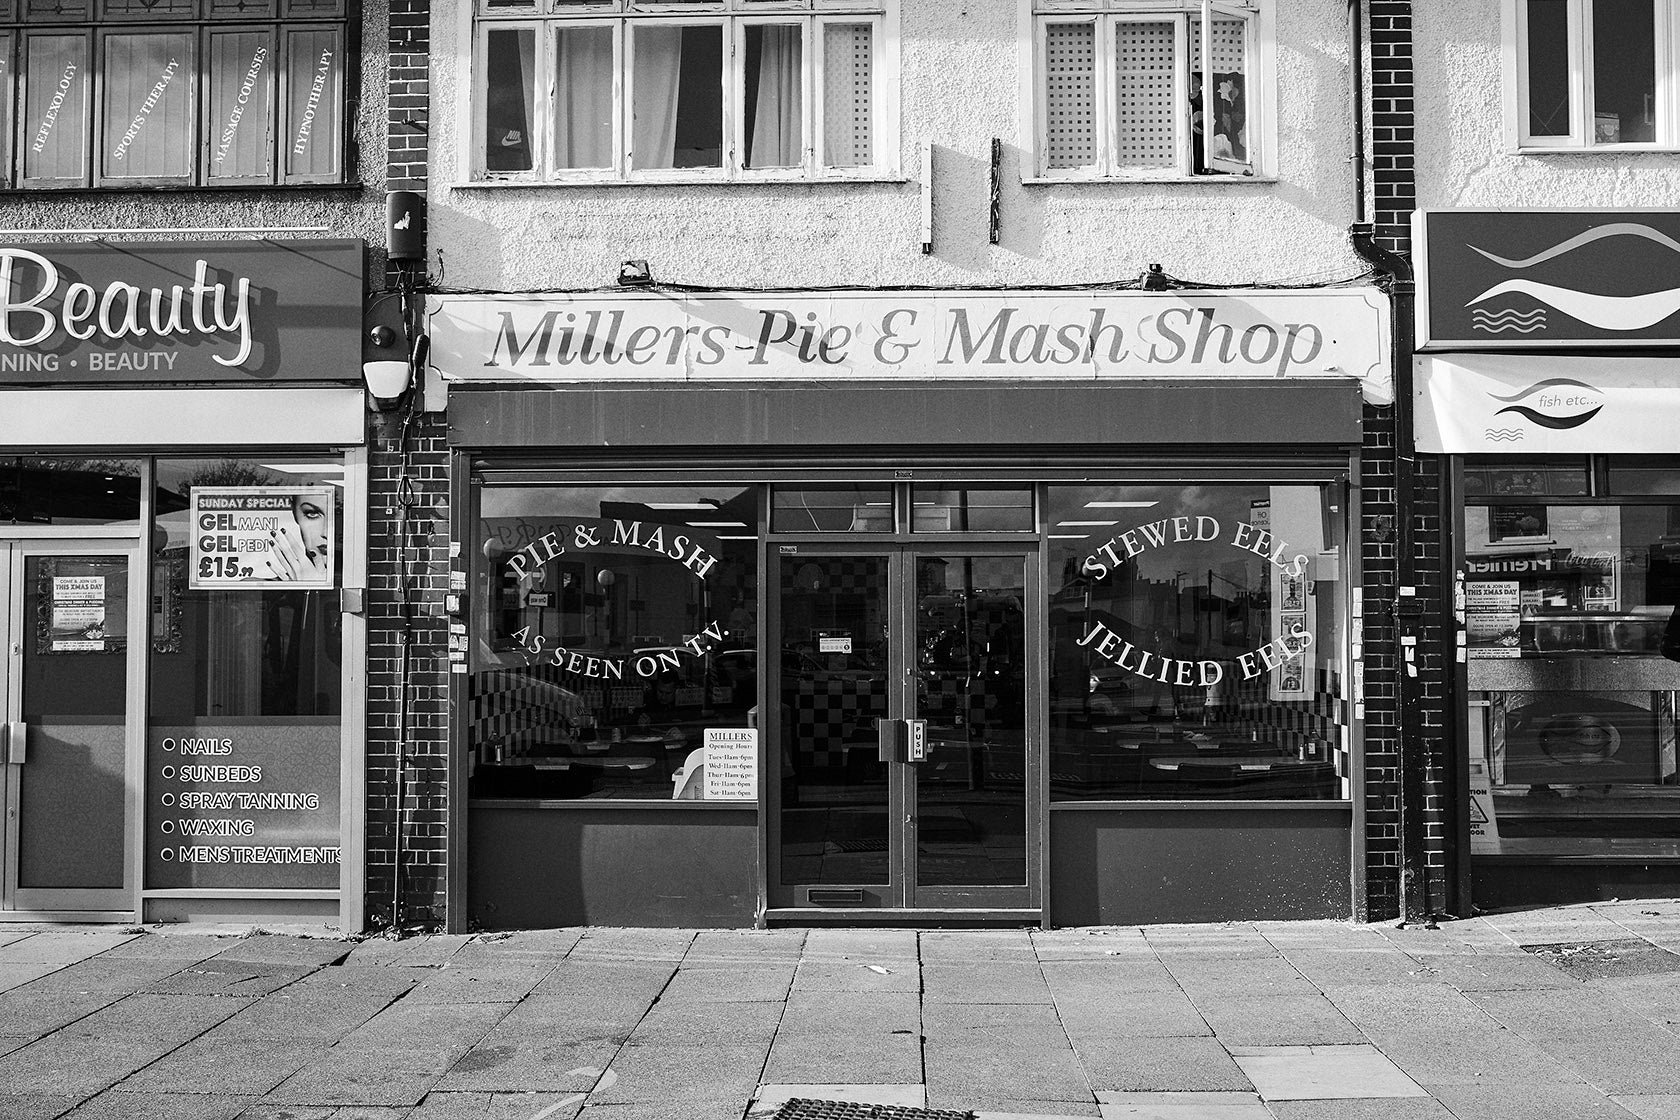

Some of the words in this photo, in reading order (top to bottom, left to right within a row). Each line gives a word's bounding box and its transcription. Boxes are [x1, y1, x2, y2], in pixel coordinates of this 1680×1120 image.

[31, 60, 78, 154] REFLEXOLOGY
[111, 113, 146, 161] SPORTS
[140, 57, 181, 118] THERAPY
[214, 104, 243, 165] MASSAGE
[237, 45, 268, 108] COURSES
[292, 47, 333, 155] HYPNOTHERAPY
[0, 248, 251, 367] Beauty
[873, 308, 921, 365] &
[937, 307, 1129, 365] Mash
[1147, 307, 1323, 377] Shop
[89, 351, 179, 372] BEAUTY
[1538, 395, 1562, 408] fish
[1566, 396, 1598, 407] etc...
[198, 498, 244, 509] SUNDAY
[246, 498, 292, 509] SPECIAL
[199, 513, 237, 531] GEL
[238, 517, 278, 531] MANI
[199, 535, 237, 553] GEL
[238, 539, 269, 553] PEDI
[506, 531, 566, 582] PIE
[574, 523, 601, 550] &
[611, 519, 719, 580] MASH
[1082, 516, 1220, 581] STEWED
[1230, 521, 1310, 578] EELS
[198, 556, 254, 578] £15.99
[510, 624, 546, 655] AS
[550, 647, 624, 679] SEEN
[636, 648, 682, 678] ON
[684, 620, 730, 659] T.V.
[1076, 620, 1223, 687] JELLIED
[1236, 622, 1315, 681] EELS
[180, 738, 233, 756] NAILS
[709, 732, 753, 740] MILLERS
[914, 726, 923, 755] PUSH
[179, 765, 263, 783] SUNBEDS
[179, 792, 238, 810] SPRAY
[237, 792, 320, 810] TANNING
[179, 819, 255, 837] WAXING
[179, 845, 232, 864] MENS
